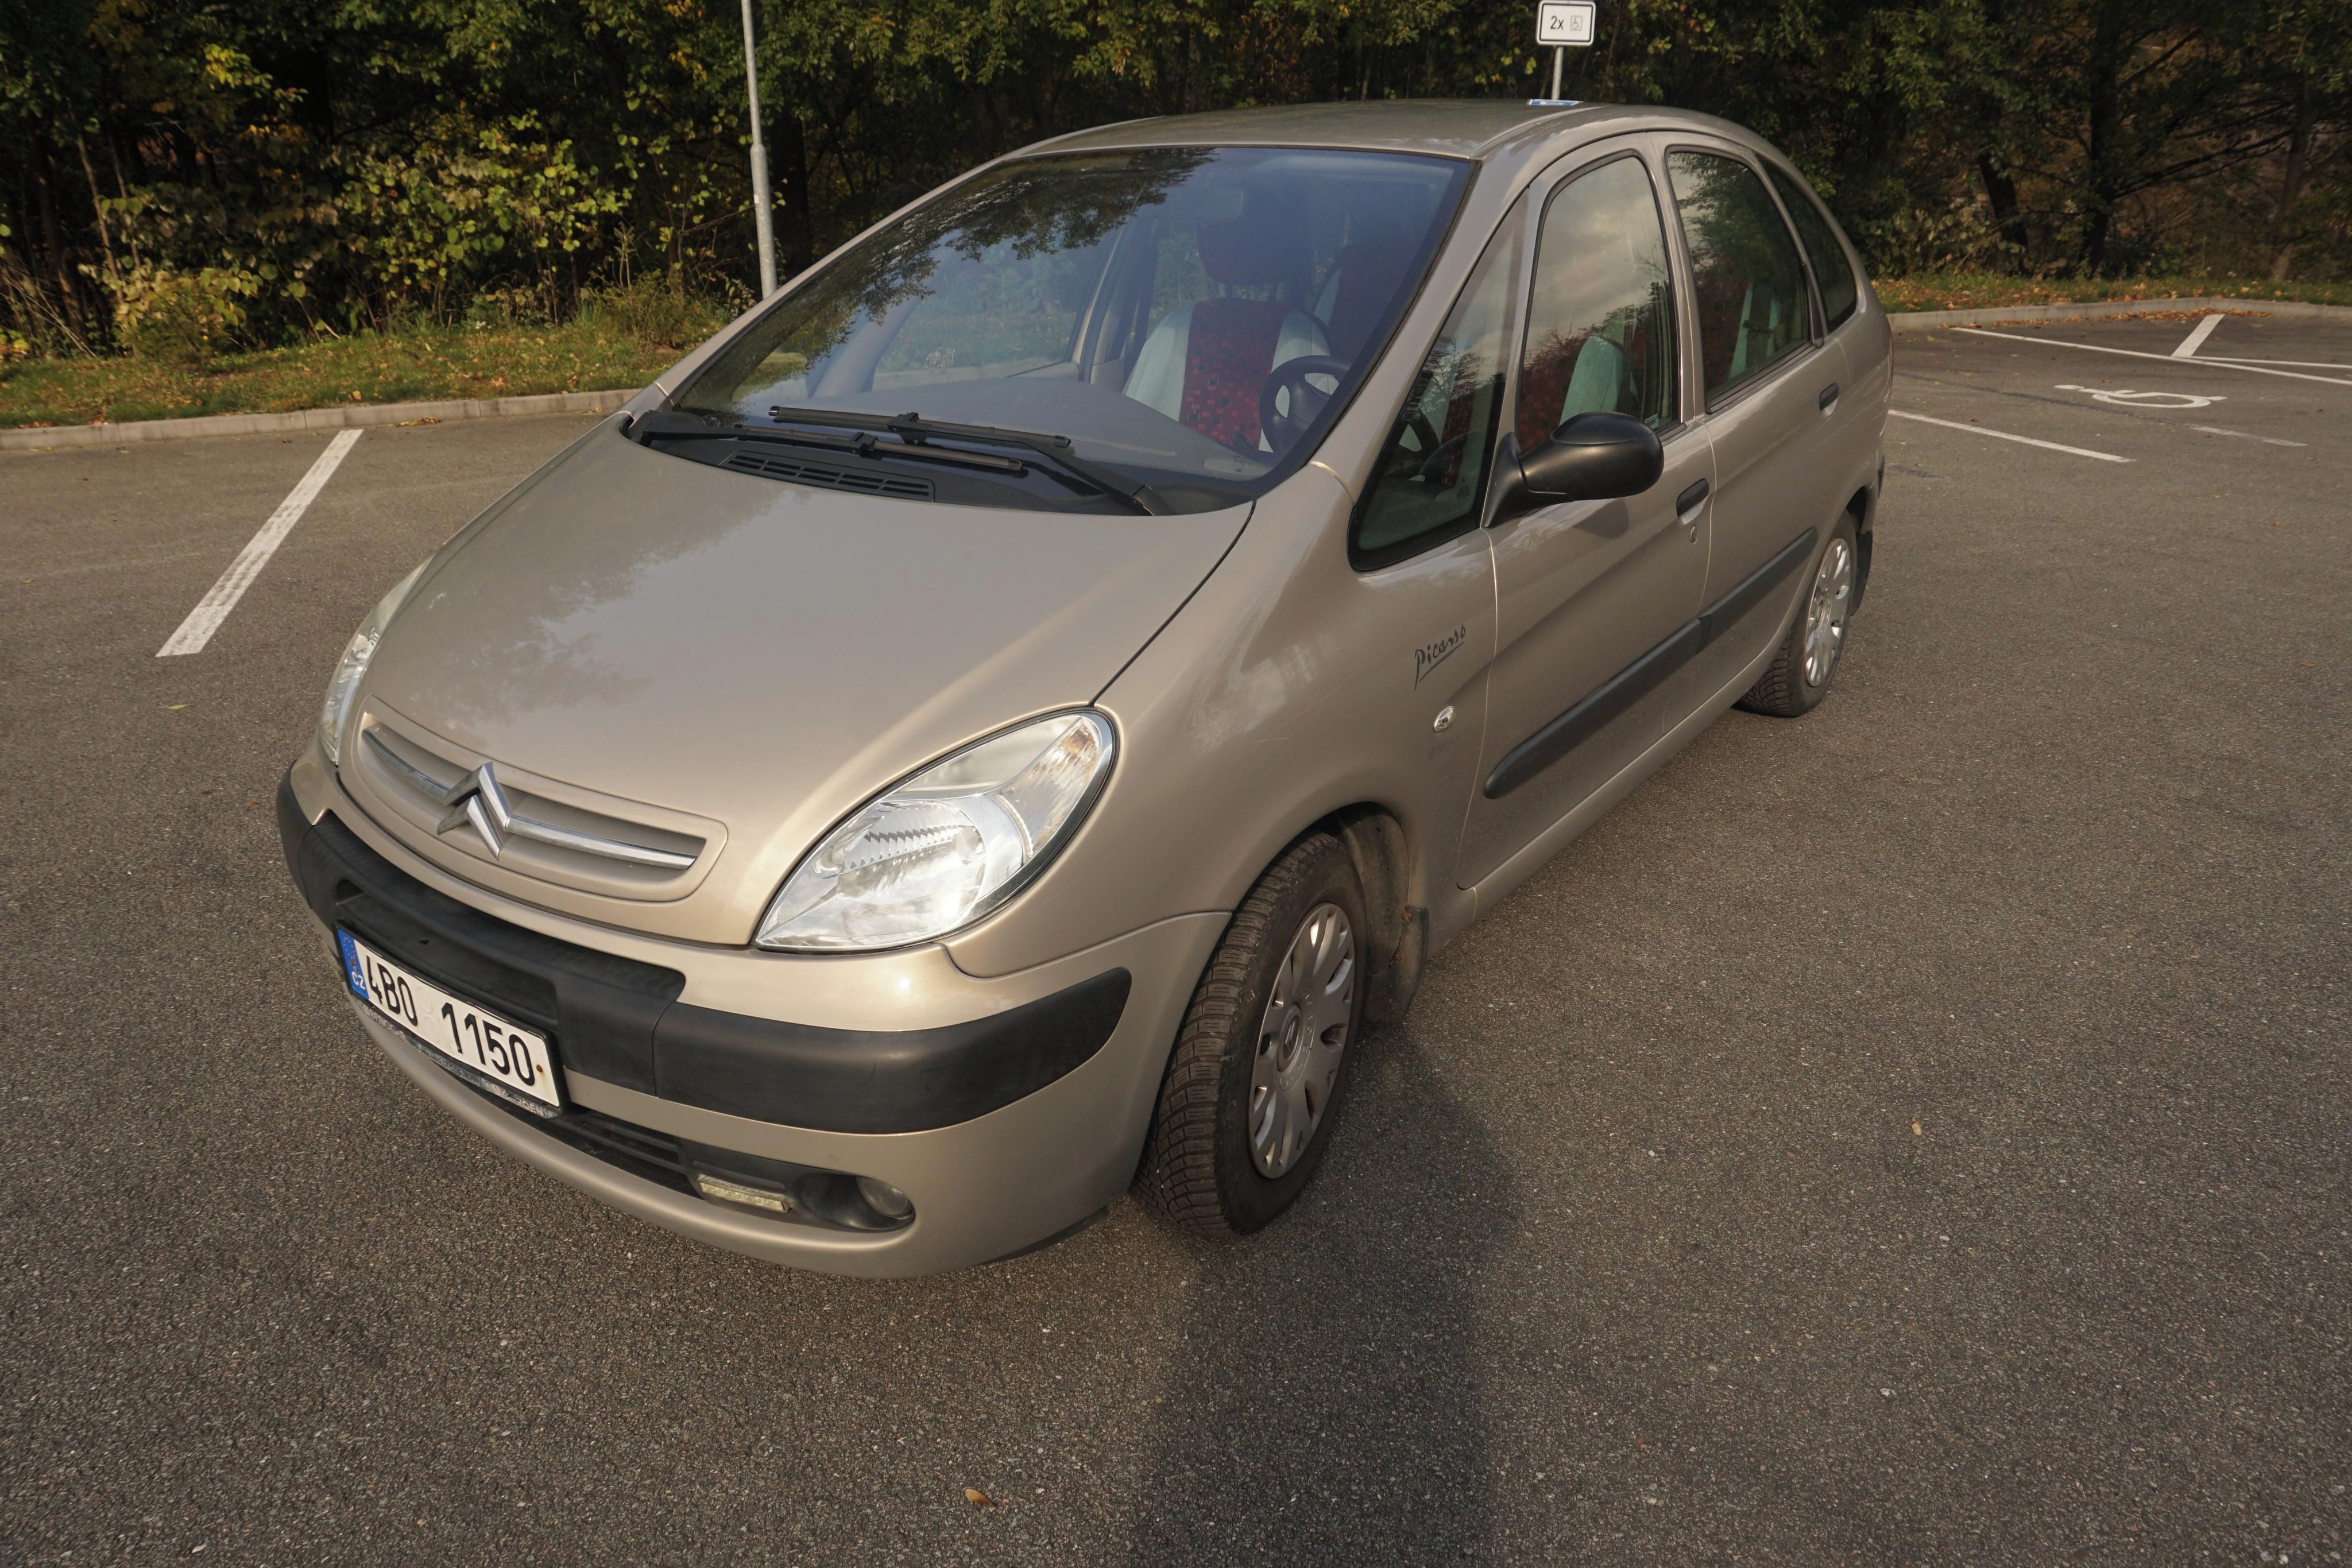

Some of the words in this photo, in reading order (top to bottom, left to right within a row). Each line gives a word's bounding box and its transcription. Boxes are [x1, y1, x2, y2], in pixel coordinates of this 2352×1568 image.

[1550, 16, 1564, 29] 2x
[1414, 624, 1466, 691] Picasso
[351, 971, 366, 990] CZ
[366, 955, 418, 1027] 4B0
[442, 1002, 535, 1086] 1150
